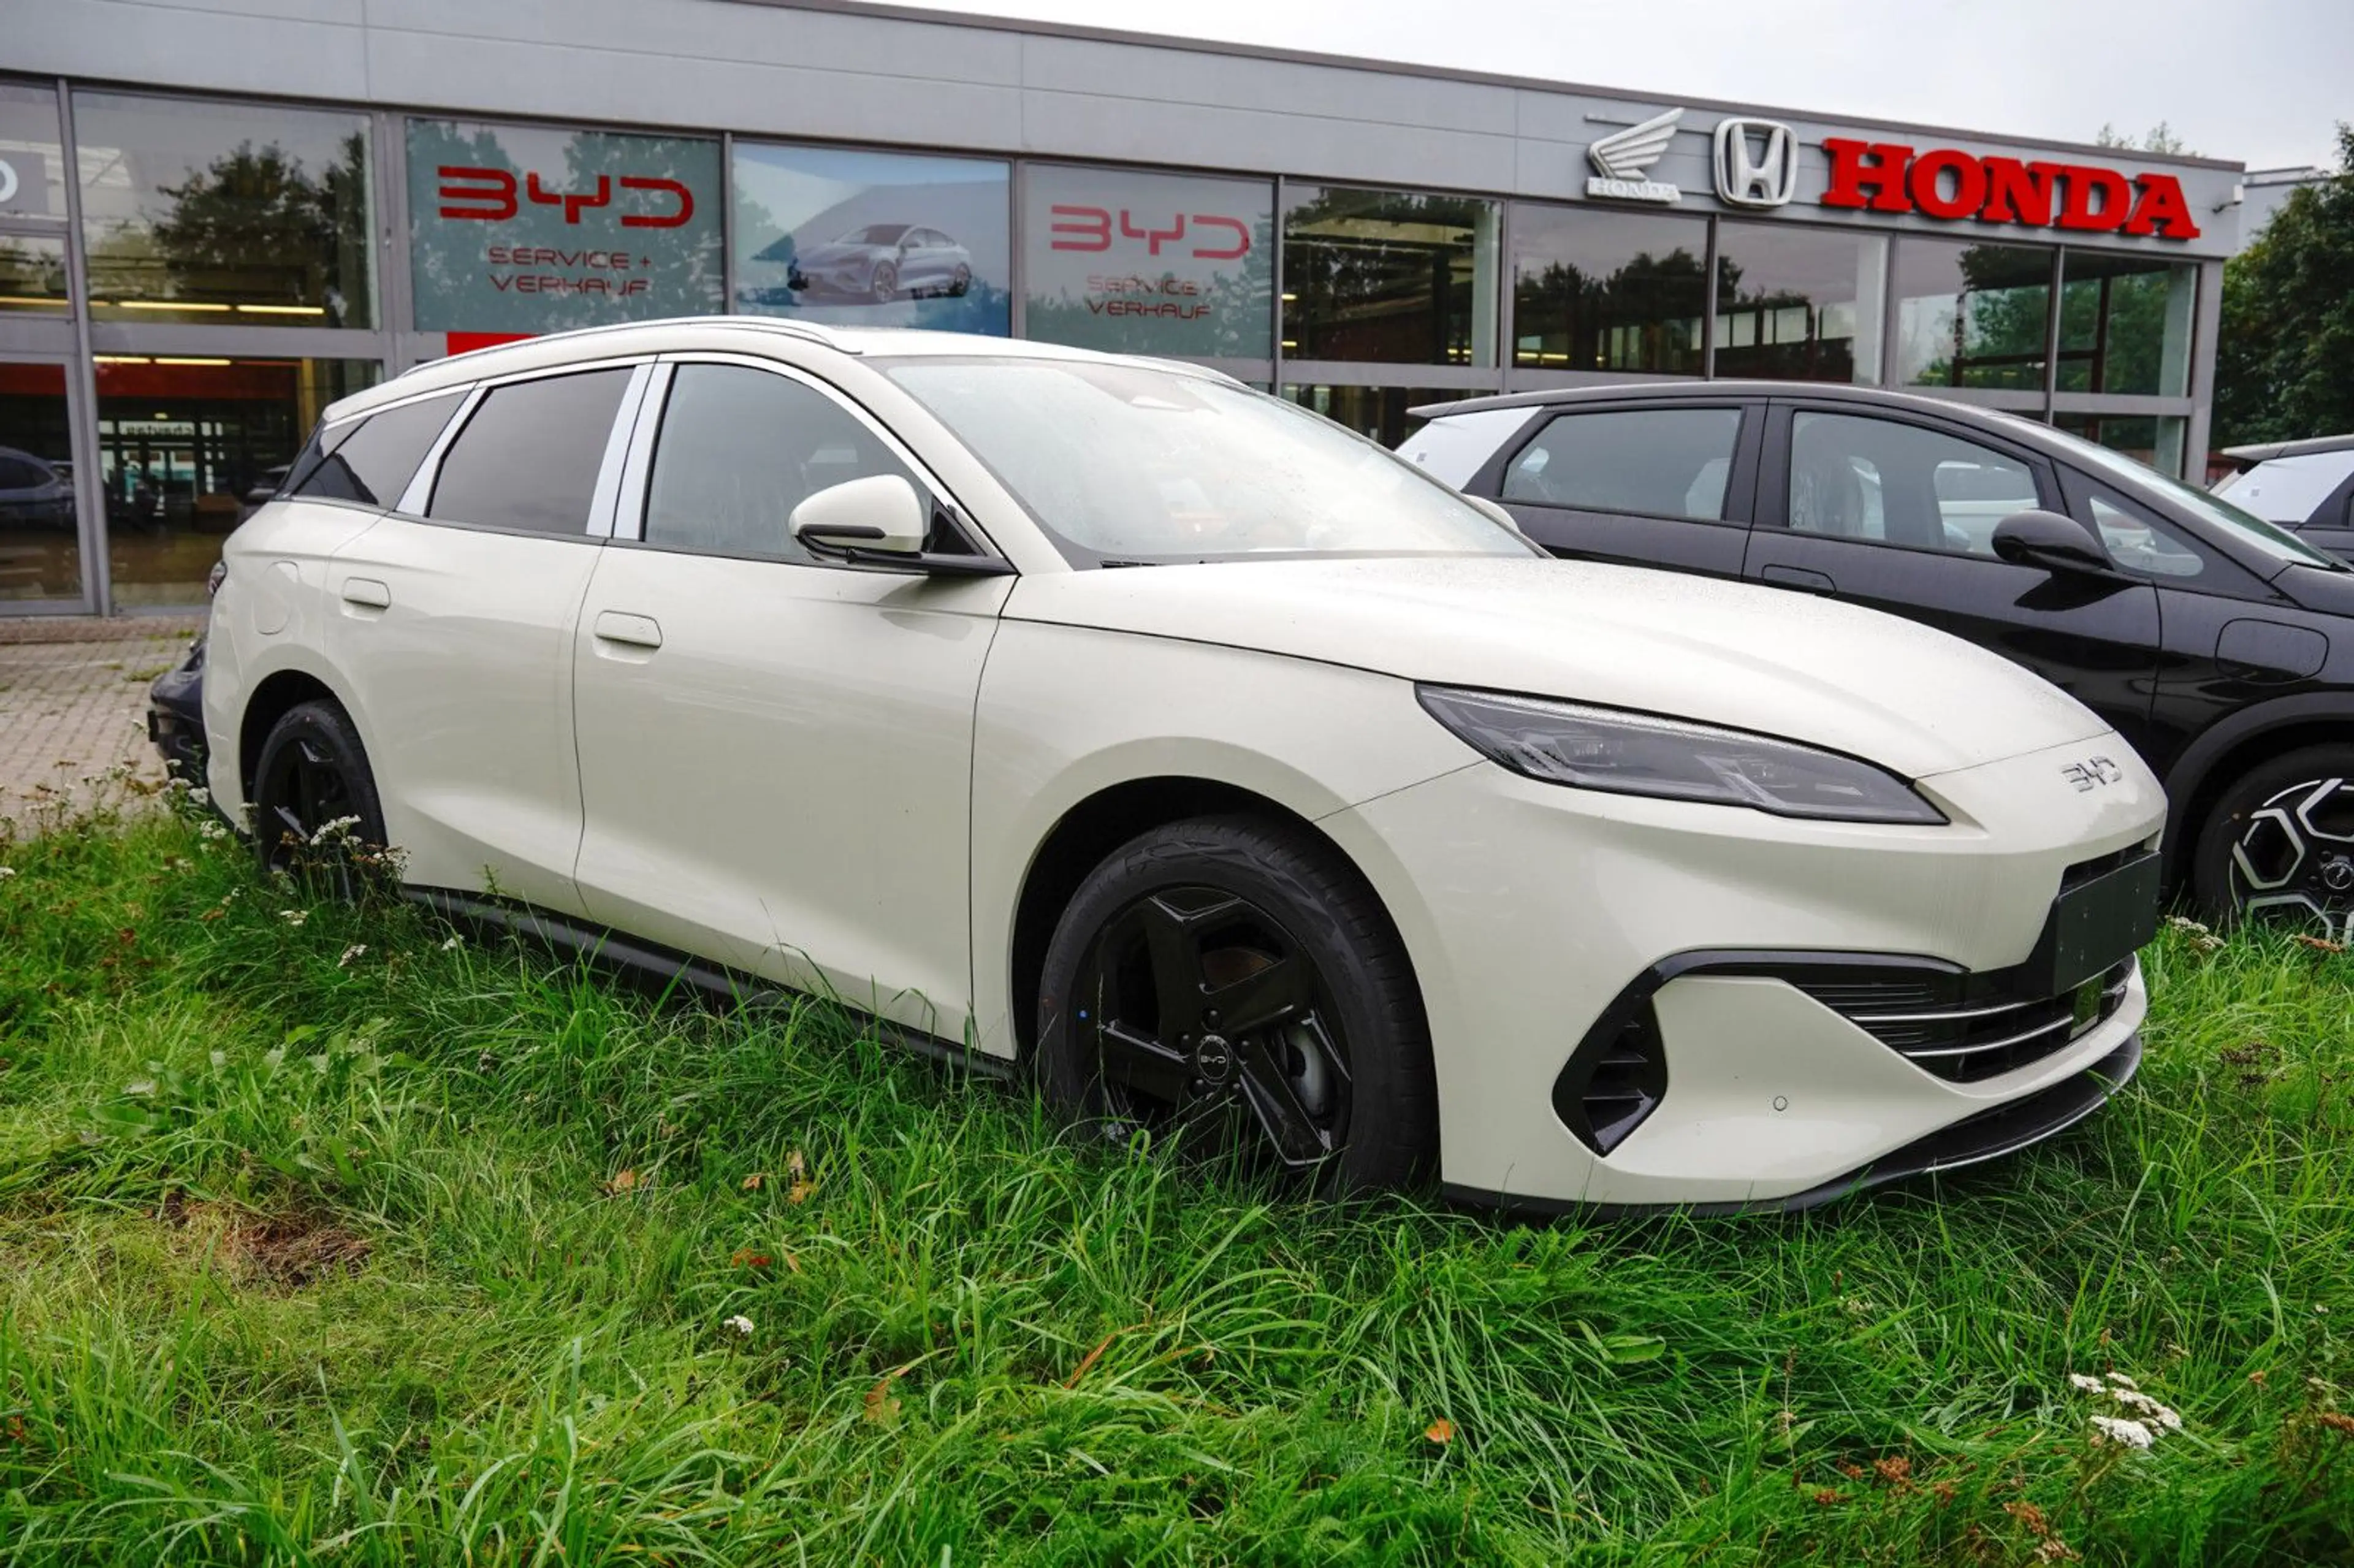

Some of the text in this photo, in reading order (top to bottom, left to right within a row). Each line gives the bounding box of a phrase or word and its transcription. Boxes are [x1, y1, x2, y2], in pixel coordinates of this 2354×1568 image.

[437, 165, 695, 228] BYD
[1588, 178, 1682, 201] HONDA
[1819, 137, 2201, 239] HONDA
[1051, 204, 1251, 259] BYD
[489, 246, 630, 269] SERVICE
[489, 274, 649, 296] VERKAUF
[1086, 297, 1211, 319] VERKAUF
[2060, 755, 2122, 793] BYD
[1200, 1055, 1226, 1064] BYD
